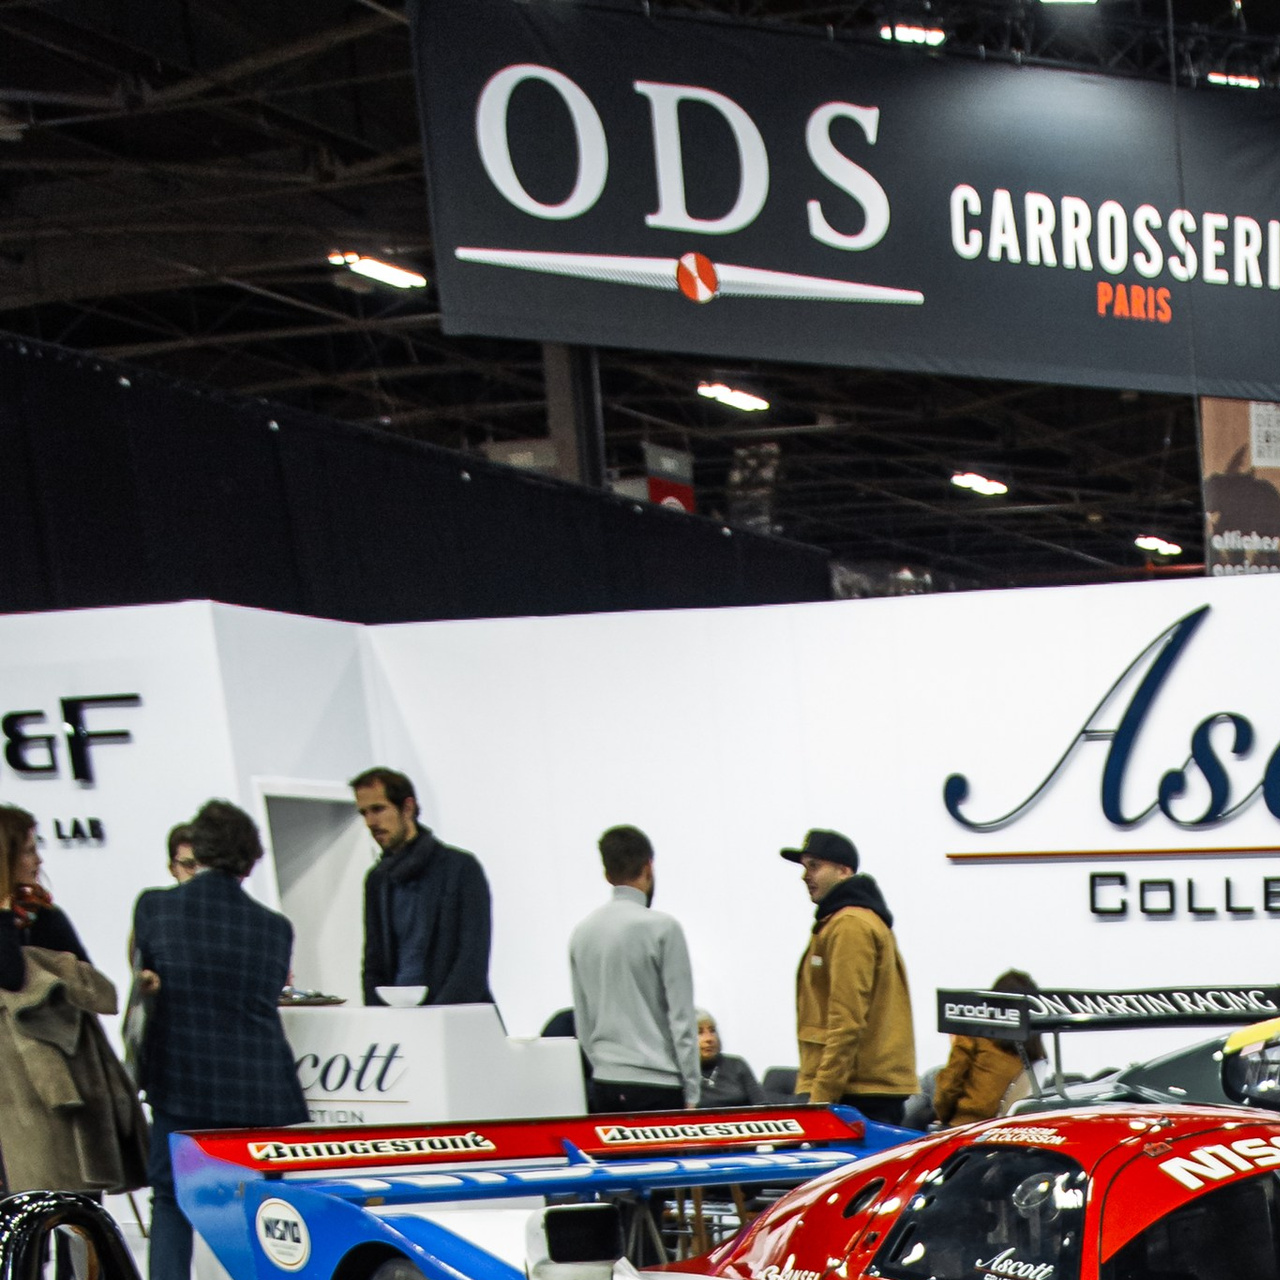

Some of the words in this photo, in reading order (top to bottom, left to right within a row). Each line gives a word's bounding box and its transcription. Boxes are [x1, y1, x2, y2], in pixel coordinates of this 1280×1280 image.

[475, 63, 891, 251] ODS
[1097, 282, 1173, 324] PARIS
[53, 818, 105, 841] LAB
[944, 1002, 1021, 1021] prodrive
[1068, 992, 1175, 1016] MARTIN
[1173, 990, 1279, 1013] RACING
[296, 1043, 409, 1092] cott
[596, 1119, 804, 1144] BRIDGESTONE
[248, 1132, 496, 1162] BRIDGESTONE
[975, 1247, 1055, 1280] Ascott
